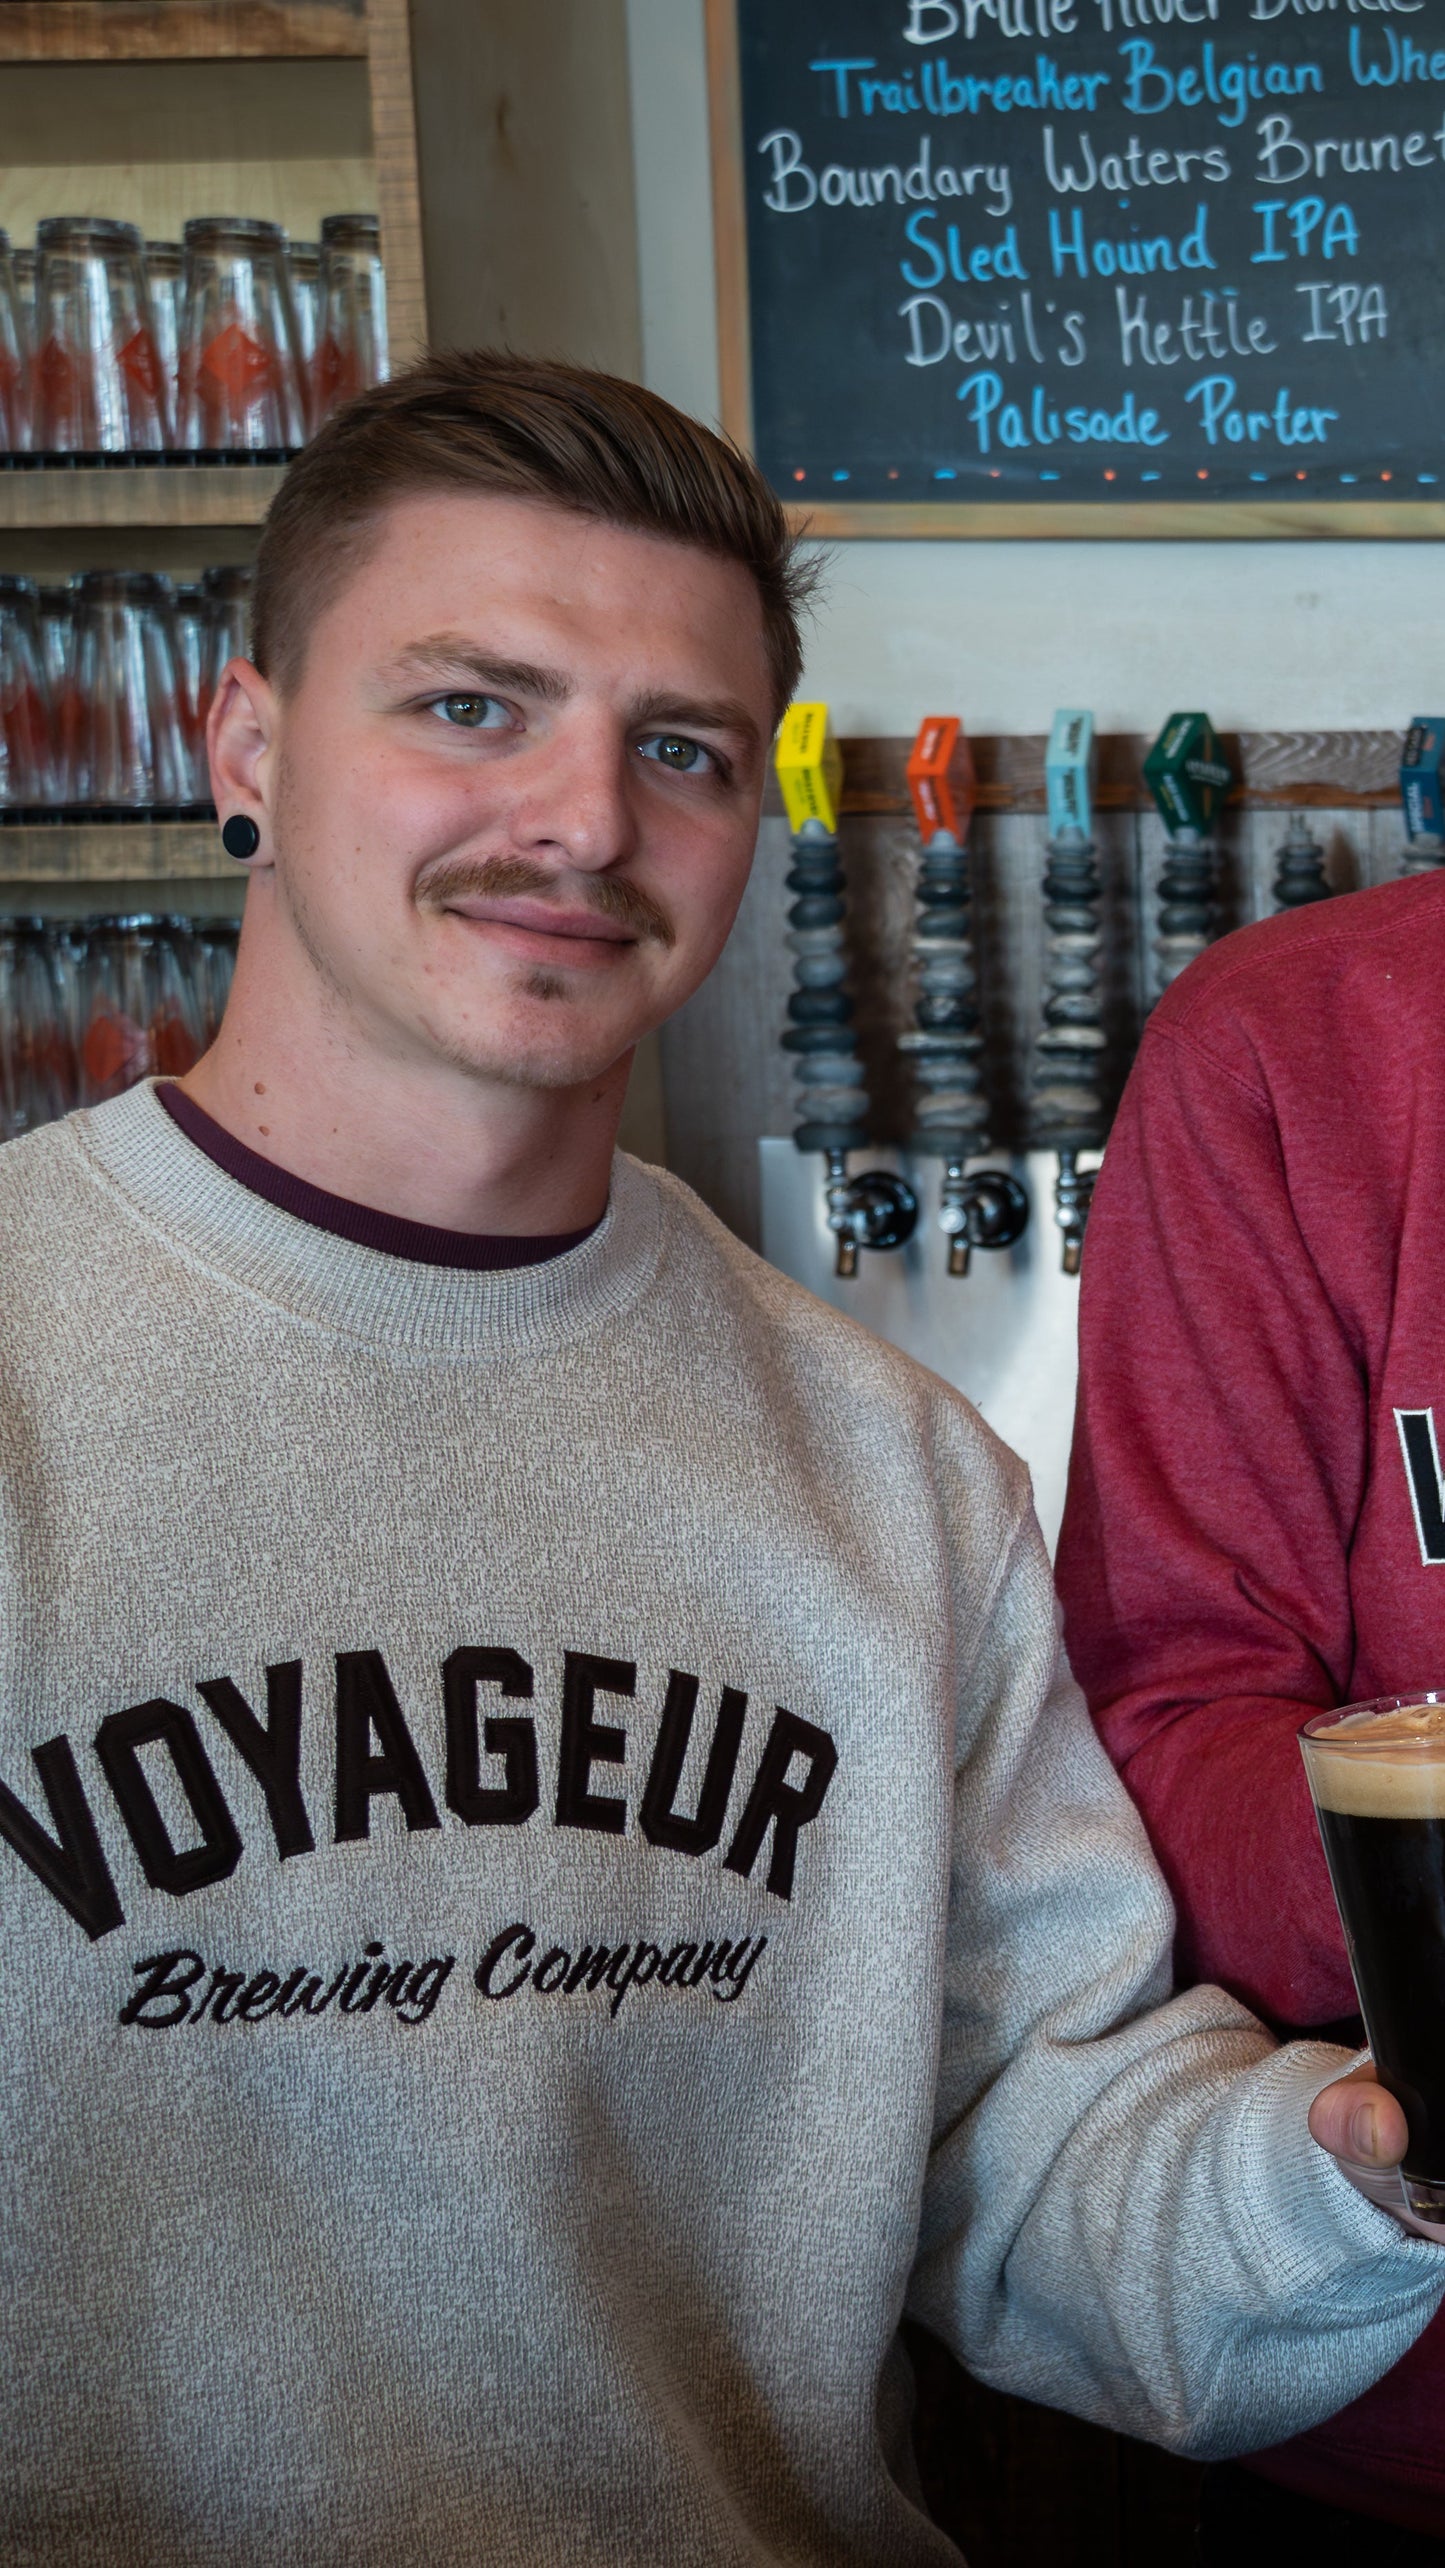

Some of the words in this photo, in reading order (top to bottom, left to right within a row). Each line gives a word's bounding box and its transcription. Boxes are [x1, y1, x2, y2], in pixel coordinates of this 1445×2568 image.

[810, 55, 1110, 118] Trailbreaker
[1118, 37, 1323, 127] Belgian
[758, 128, 1010, 216] Boundary
[1043, 125, 1231, 192] Waters
[900, 208, 1028, 289] Sled
[1250, 198, 1359, 264] IPA
[899, 287, 1086, 367] Devil's
[1115, 286, 1278, 366] Kettle
[1296, 282, 1389, 346] IPA
[956, 370, 1169, 453] Palisade
[1184, 374, 1339, 446] Porter
[0, 1646, 840, 1942] VOYAGEUR
[119, 1941, 457, 2029] Brewing
[474, 1923, 768, 2018] Company
